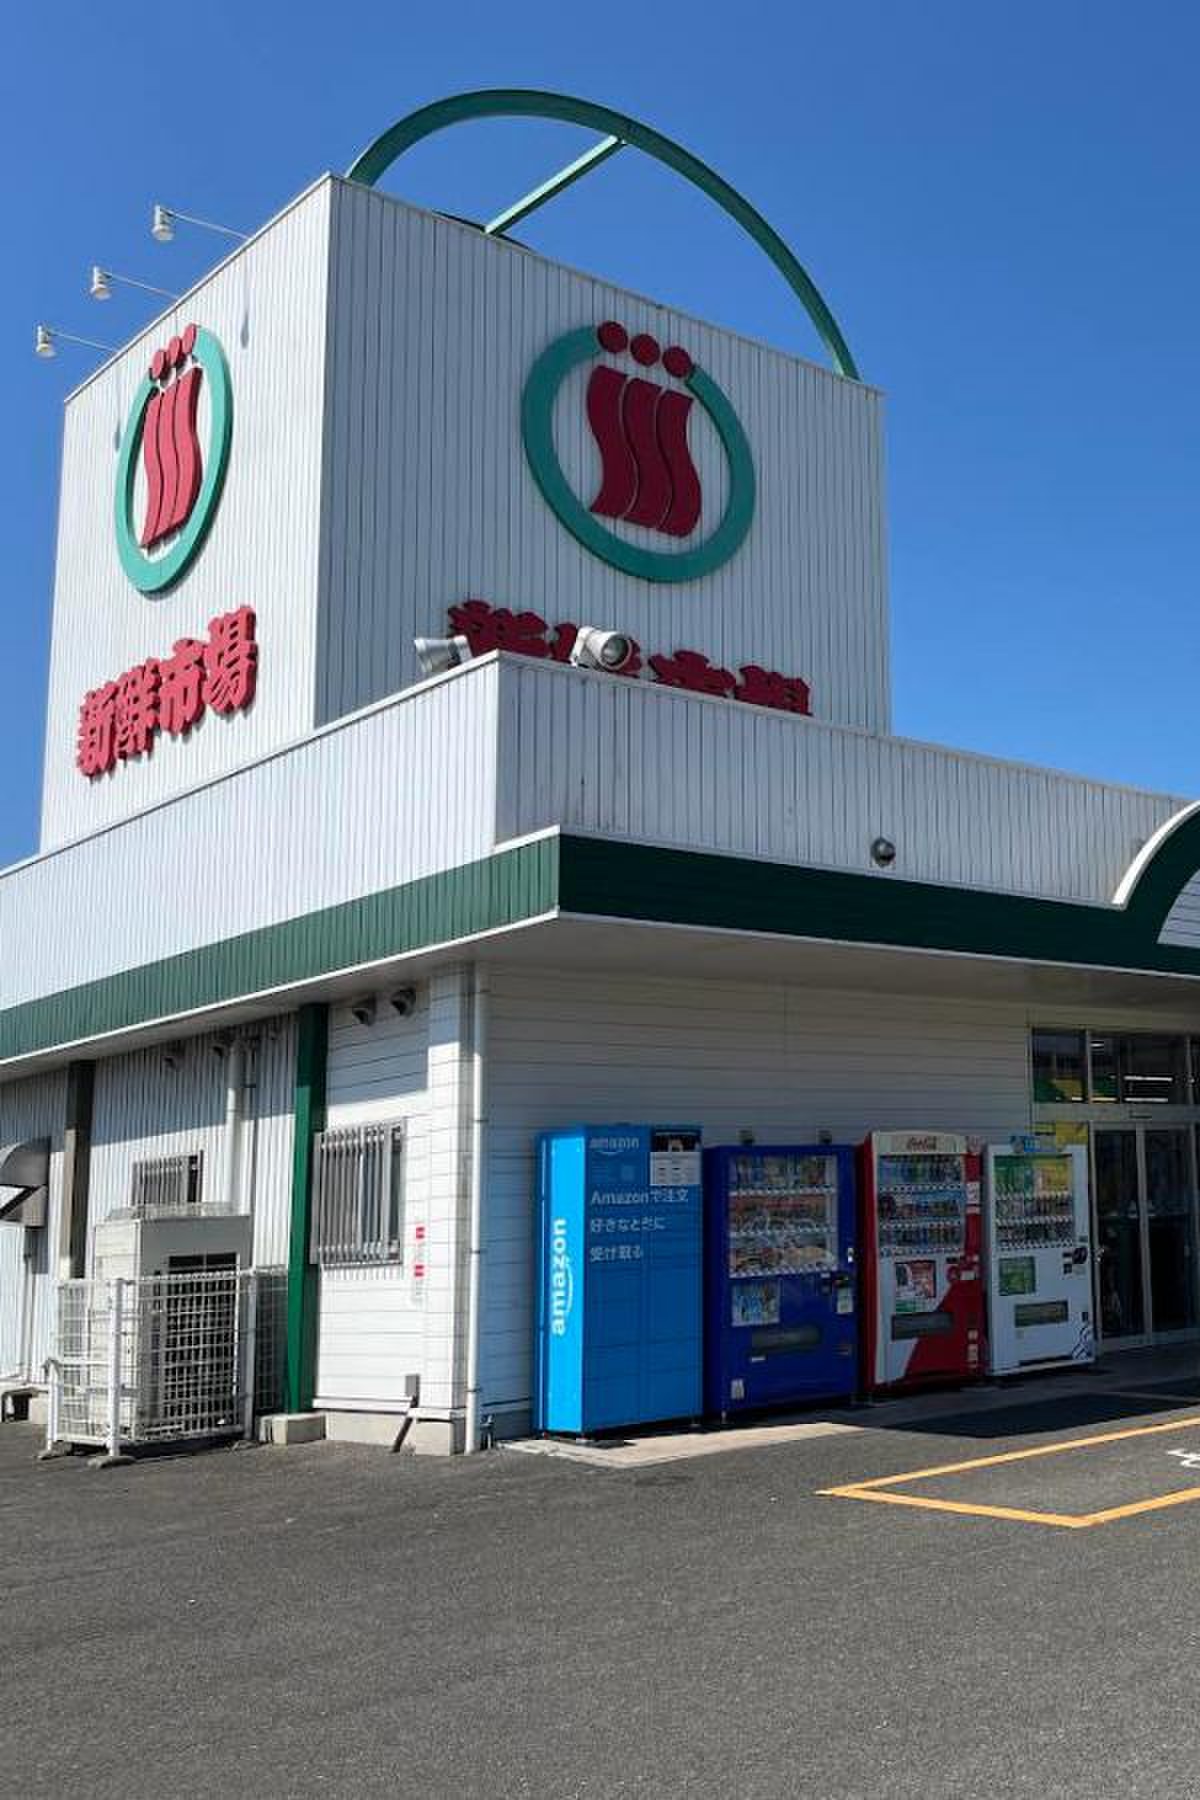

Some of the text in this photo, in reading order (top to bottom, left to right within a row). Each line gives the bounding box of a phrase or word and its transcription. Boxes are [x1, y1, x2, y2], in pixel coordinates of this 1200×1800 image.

[77, 604, 256, 776] 新鮮市場
[551, 1217, 568, 1337] amazon
